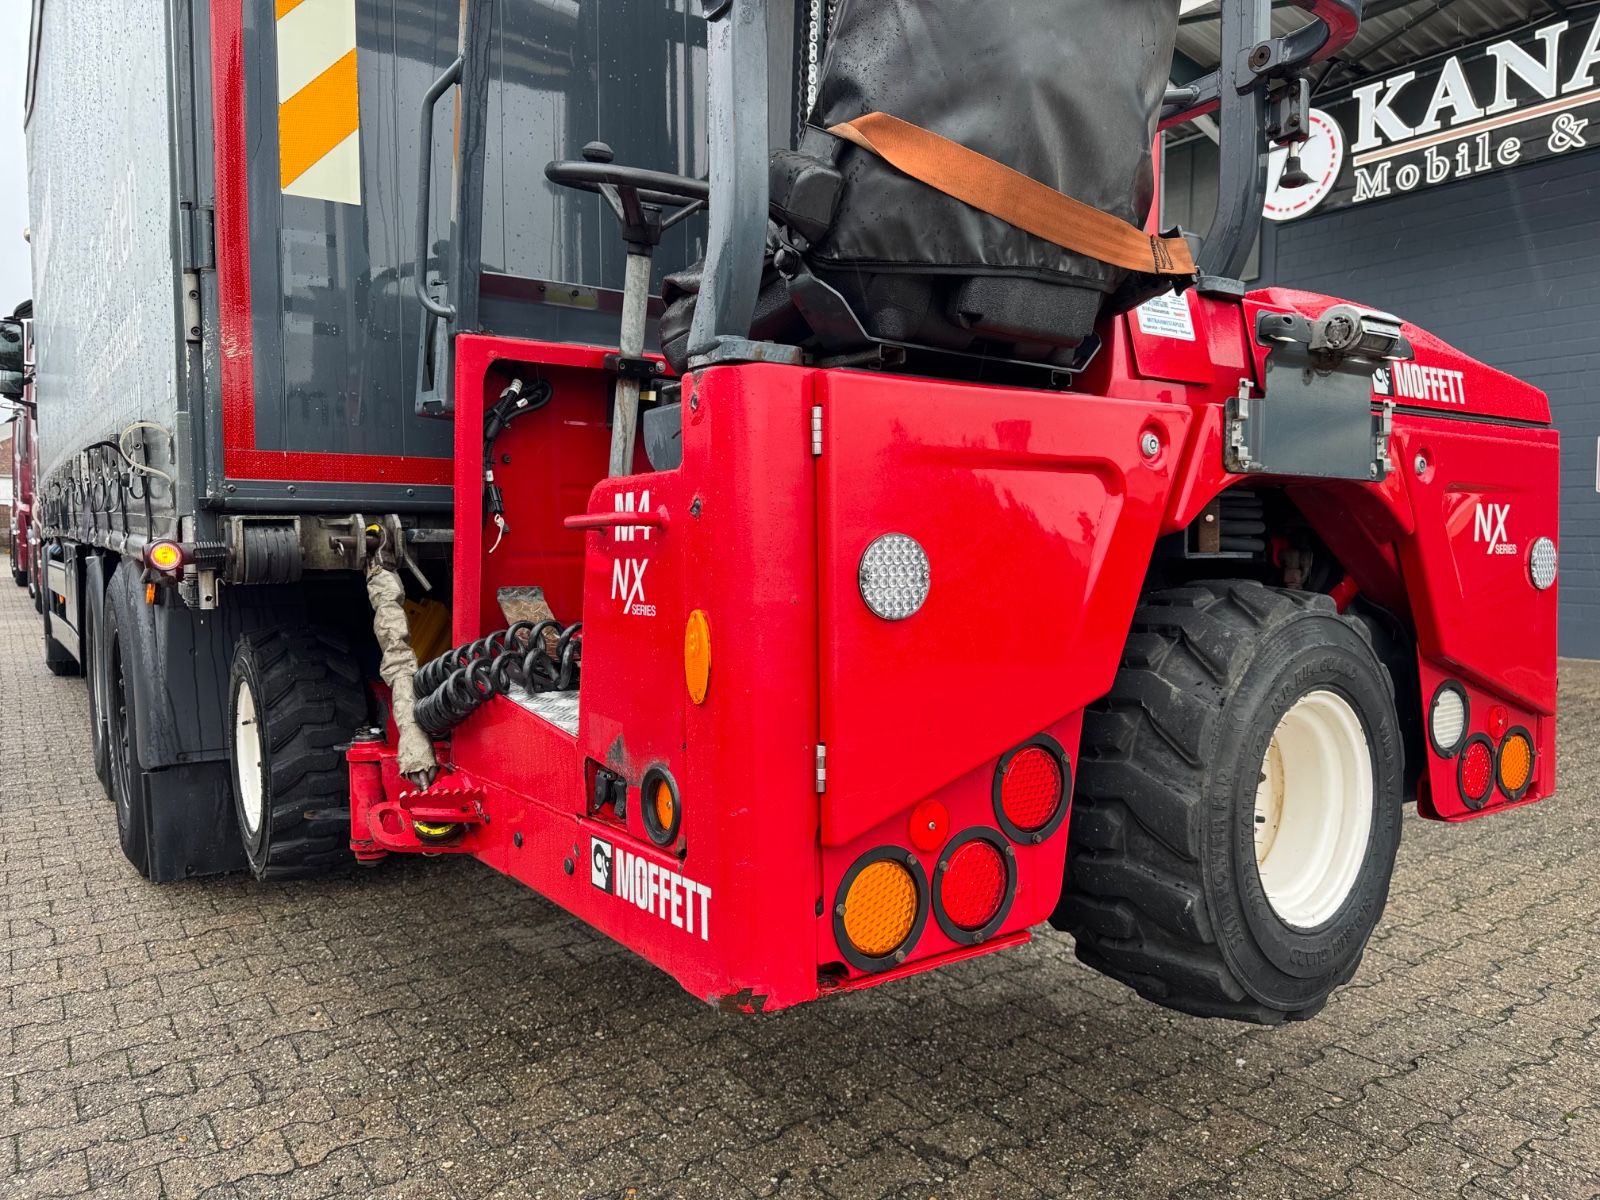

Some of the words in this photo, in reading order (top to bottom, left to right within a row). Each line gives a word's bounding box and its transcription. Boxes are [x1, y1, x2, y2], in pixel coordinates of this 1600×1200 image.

[1352, 131, 1521, 203] Mobile
[1547, 112, 1589, 153] &
[1393, 361, 1466, 405] MOFFETT
[614, 489, 653, 542] M4
[1474, 502, 1511, 555] NX
[1494, 543, 1517, 555] SERIES
[611, 557, 649, 615] NX
[631, 603, 657, 617] SERIES
[615, 847, 712, 942] MOFFETT
